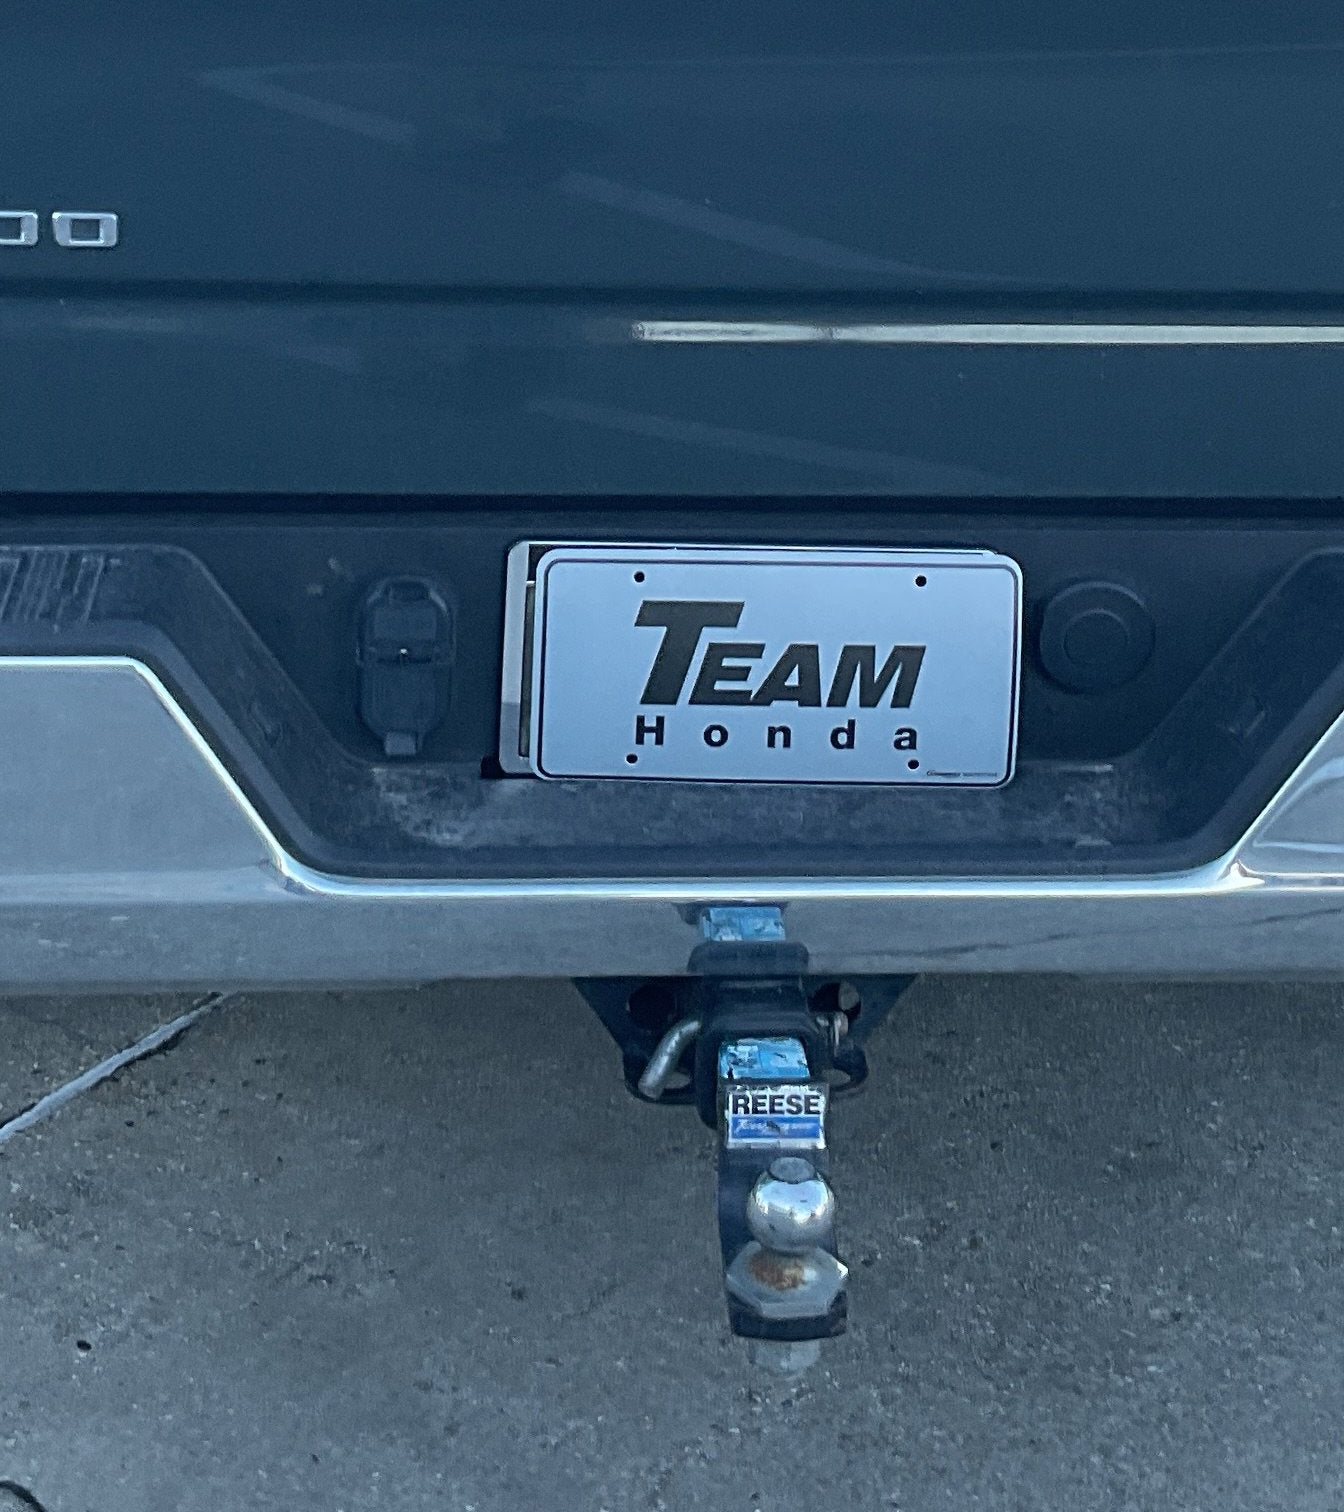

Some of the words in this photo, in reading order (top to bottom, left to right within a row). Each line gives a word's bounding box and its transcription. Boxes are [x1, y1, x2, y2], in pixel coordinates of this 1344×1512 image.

[634, 599, 927, 709] TEAM
[635, 715, 918, 752] Honda
[732, 1094, 821, 1116] REESE
